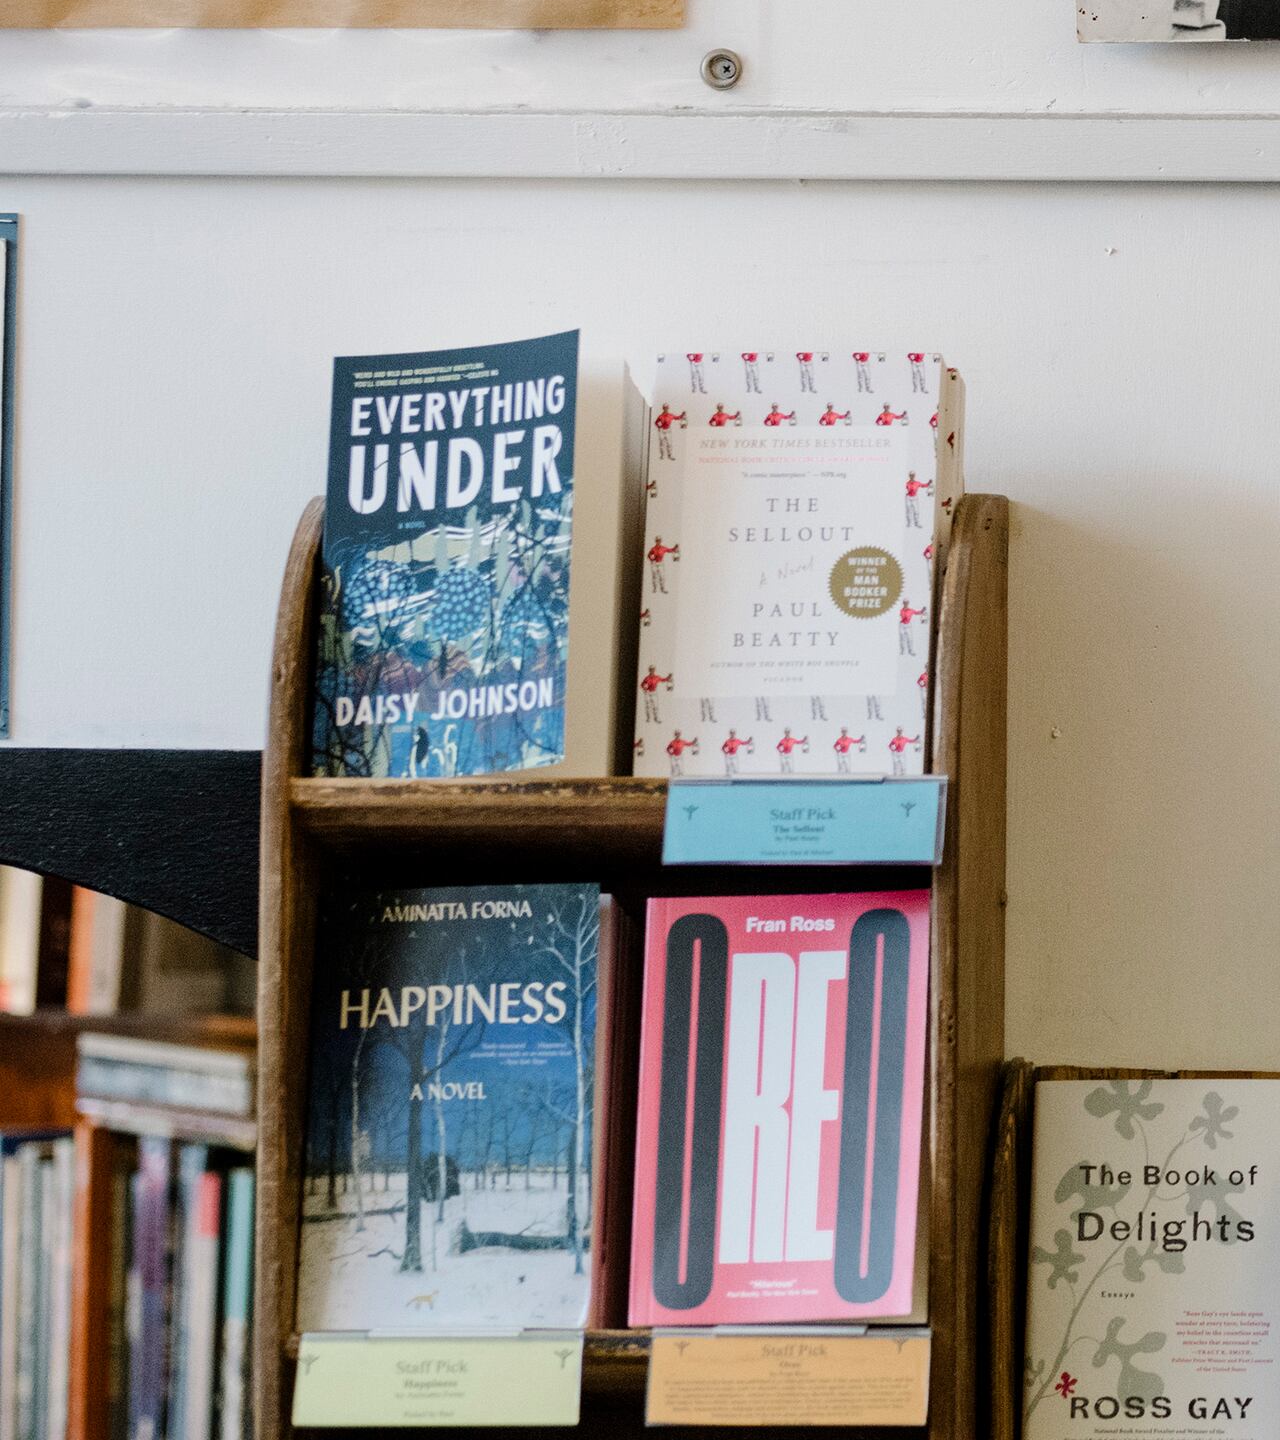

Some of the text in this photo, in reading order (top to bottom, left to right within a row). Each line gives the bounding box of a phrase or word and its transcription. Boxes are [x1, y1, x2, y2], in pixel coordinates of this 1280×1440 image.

[350, 375, 566, 437] EVERYTHING
[700, 438, 892, 449] NEW YORK TIMES BESTSELLER
[348, 424, 563, 515] UNDER
[766, 497, 819, 513] THE
[728, 526, 854, 543] SELLOUT
[847, 557, 887, 566] WINNER
[853, 575, 880, 586] MAN
[843, 586, 888, 597] BOOKER
[752, 602, 822, 618] PAUL
[848, 598, 882, 609] PRIZE
[733, 631, 839, 648] BEATTY
[335, 676, 554, 727] DAISY JOHNSON
[769, 807, 835, 820] Staff Pick
[382, 900, 533, 923] AMINATTA FORNA
[745, 914, 836, 933] Fran Ross
[339, 981, 567, 1030] HAPPINESS
[409, 1082, 487, 1100] A NOVEL
[652, 907, 911, 1310] OREO
[1078, 1164, 1259, 1185] The Book of
[1077, 1211, 1256, 1253] Delights
[1101, 1290, 1136, 1300] Essays
[1070, 1396, 1253, 1420] ROSS GAY
